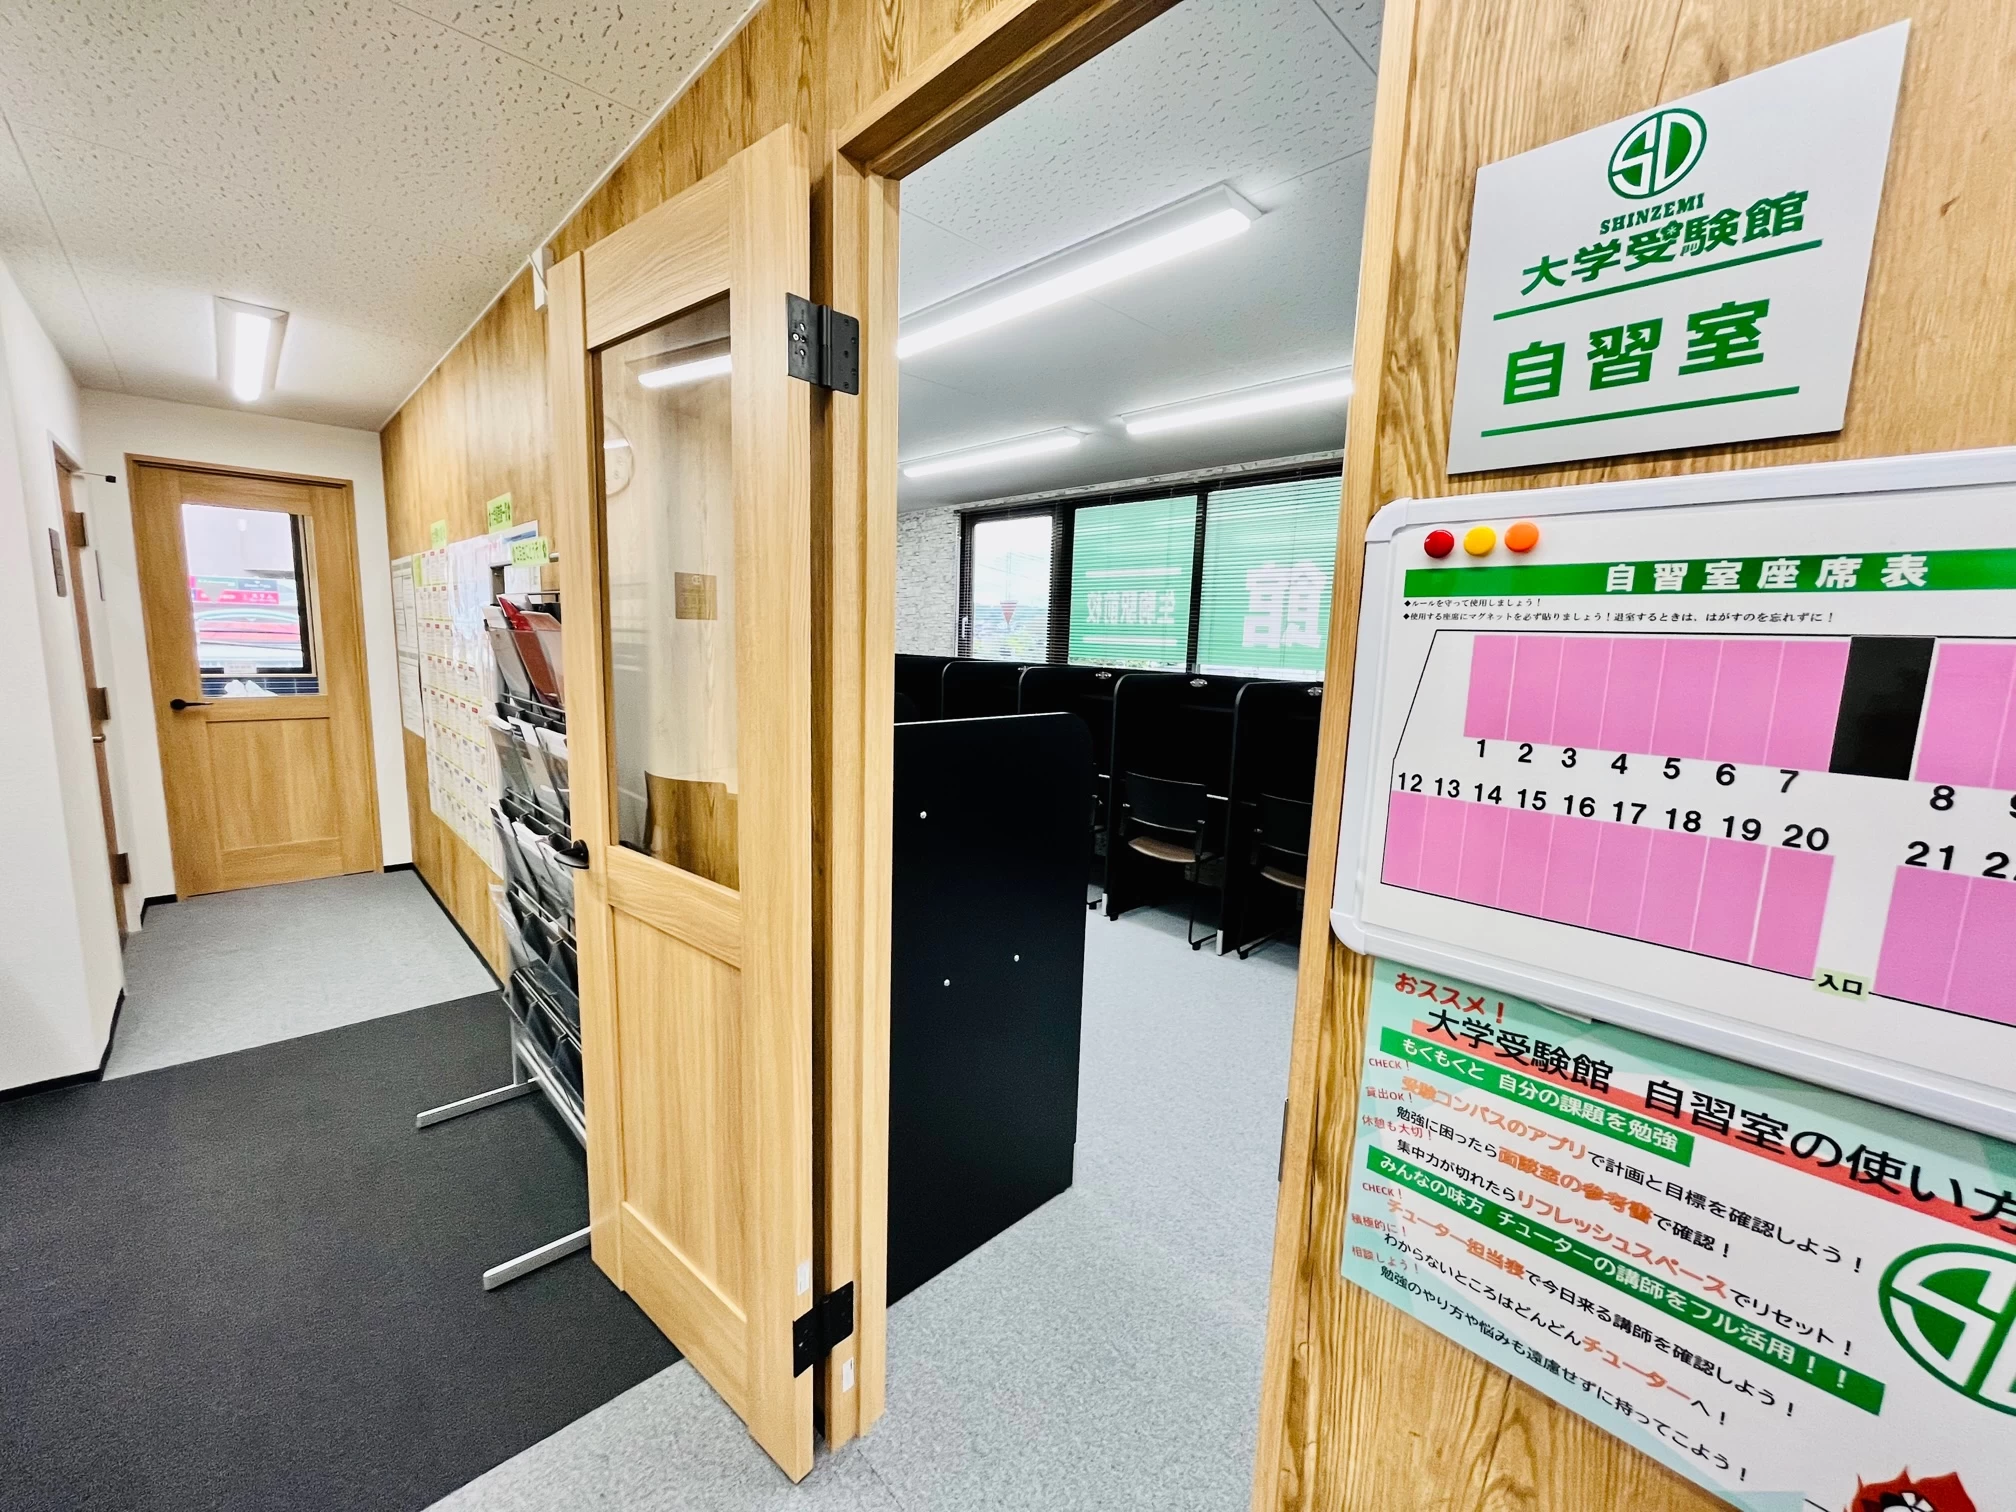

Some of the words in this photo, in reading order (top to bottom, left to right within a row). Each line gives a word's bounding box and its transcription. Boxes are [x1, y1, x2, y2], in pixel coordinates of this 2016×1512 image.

[1600, 192, 1706, 235] SHINZEMI
[1520, 189, 1810, 296] 大学受験館
[1502, 298, 1771, 405] 自習室
[1604, 553, 1929, 592] 自習室座席表
[1412, 598, 1541, 608] ルールを守って使用しましょう！
[1476, 739, 1486, 758] 1
[1517, 743, 1534, 763] 2
[1561, 747, 1577, 768] 3
[1610, 753, 1628, 774] 4
[1662, 757, 1681, 779] 5
[1715, 763, 1736, 786] 6
[1779, 769, 1799, 793] 7
[1929, 785, 1955, 811] 8
[1398, 772, 1423, 793] 12
[1434, 777, 1461, 799] 13
[1474, 783, 1502, 805] 14
[1517, 788, 1547, 811] 15
[1563, 794, 1596, 818] 16
[1612, 801, 1648, 825] 17
[1665, 808, 1702, 833] 18
[1722, 815, 1762, 842] 19
[1781, 823, 1830, 851] 20
[1904, 840, 1955, 871] 21
[1982, 851, 2016, 881] 2
[1394, 972, 1505, 1024] おススメ！
[1817, 973, 1864, 997] 入口
[1368, 1057, 1410, 1072] CHECK！
[1426, 1008, 1614, 1094] 大学受験館
[1402, 1038, 1486, 1082] もくもくと
[1498, 1073, 1679, 1153] 自分の課題を勉強
[1363, 1182, 1402, 1199] CHECK！
[1380, 1155, 1486, 1215] みんなの味方
